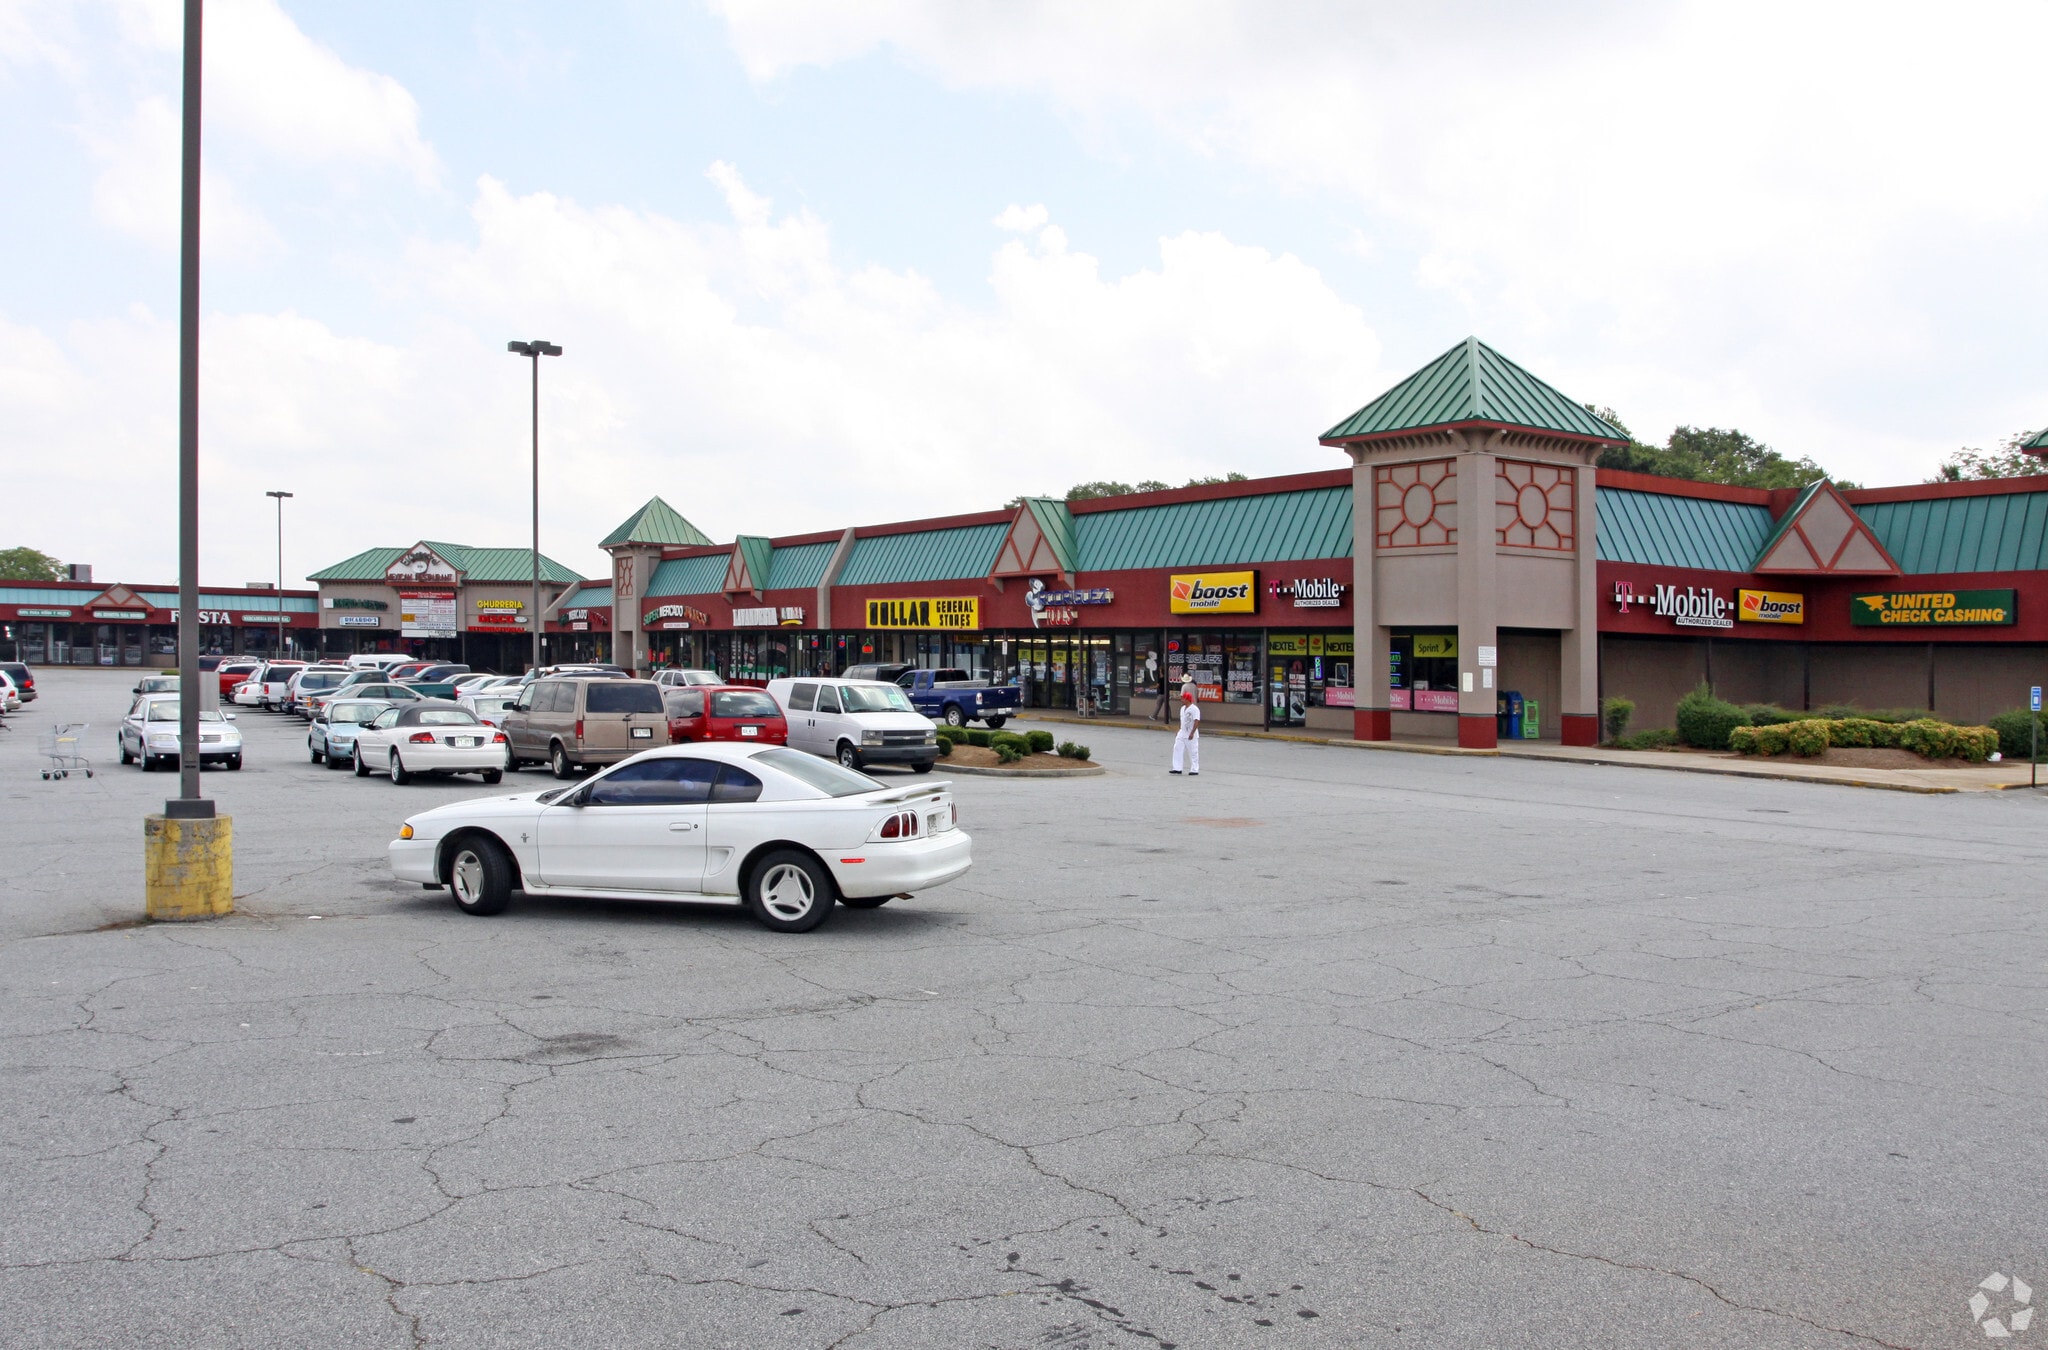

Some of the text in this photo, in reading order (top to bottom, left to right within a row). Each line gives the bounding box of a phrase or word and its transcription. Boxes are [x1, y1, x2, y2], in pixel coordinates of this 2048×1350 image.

[415, 573, 453, 581] RESTAURANT
[1190, 580, 1249, 600] boost
[1039, 588, 1110, 605] RODRIGUEZ
[1890, 593, 1956, 609] UNITED
[477, 600, 523, 609] CHURRERIA
[936, 600, 974, 613] GENERAL
[1190, 600, 1220, 608] mobile
[1760, 595, 1801, 614] boost
[660, 605, 684, 617] MERCADO
[869, 601, 930, 626] DOLLAR
[1045, 605, 1073, 625] TOOLS
[1880, 608, 2005, 623] CHECK CASHING
[170, 610, 231, 625] FSTA
[939, 614, 971, 626] STORES
[1677, 617, 1733, 627] AUTHORIZED DEALER
[1269, 642, 1297, 651] NEXTEL
[1418, 644, 1439, 654] Sprint
[1198, 688, 1219, 699] TIHL
